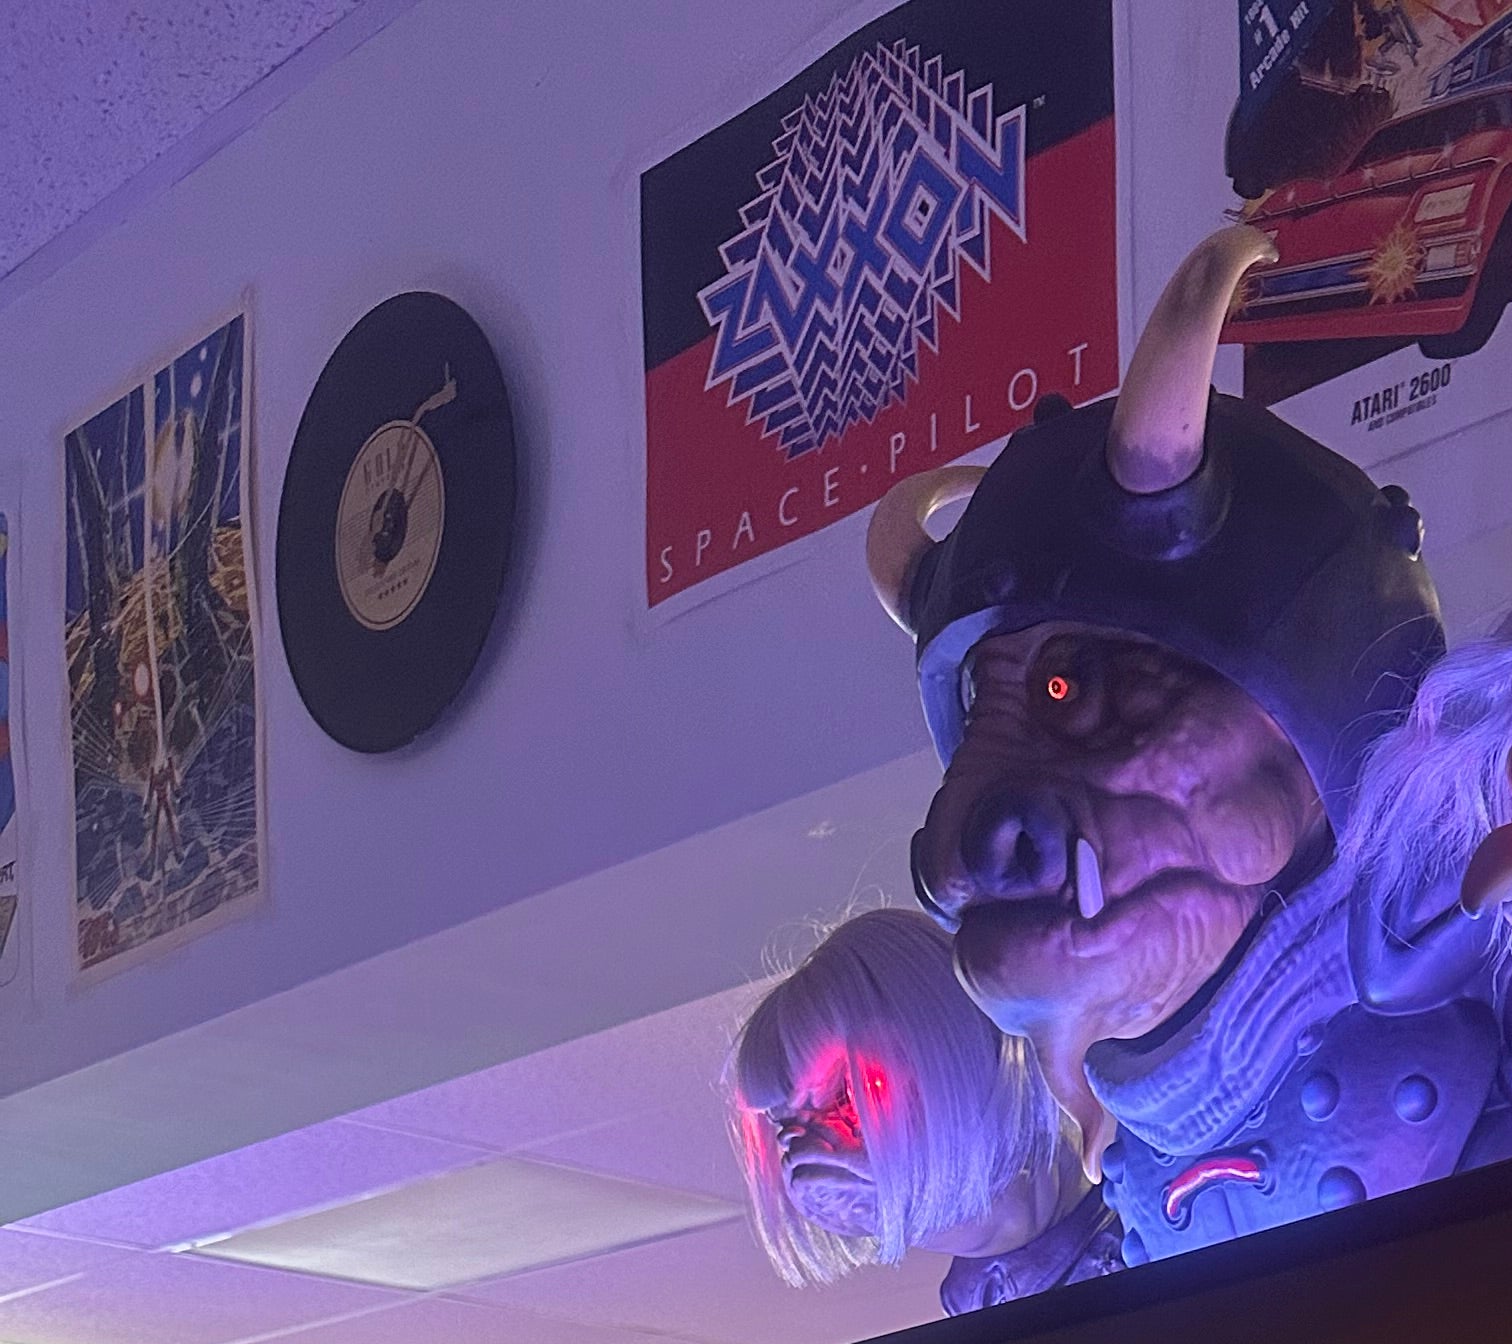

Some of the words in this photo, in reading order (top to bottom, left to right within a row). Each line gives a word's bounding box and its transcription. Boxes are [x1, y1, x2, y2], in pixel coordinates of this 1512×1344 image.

[659, 466, 841, 584] SPACE
[889, 342, 1089, 474] PILOT
[1350, 384, 1400, 427] ATARI
[1409, 363, 1451, 401] 2600
